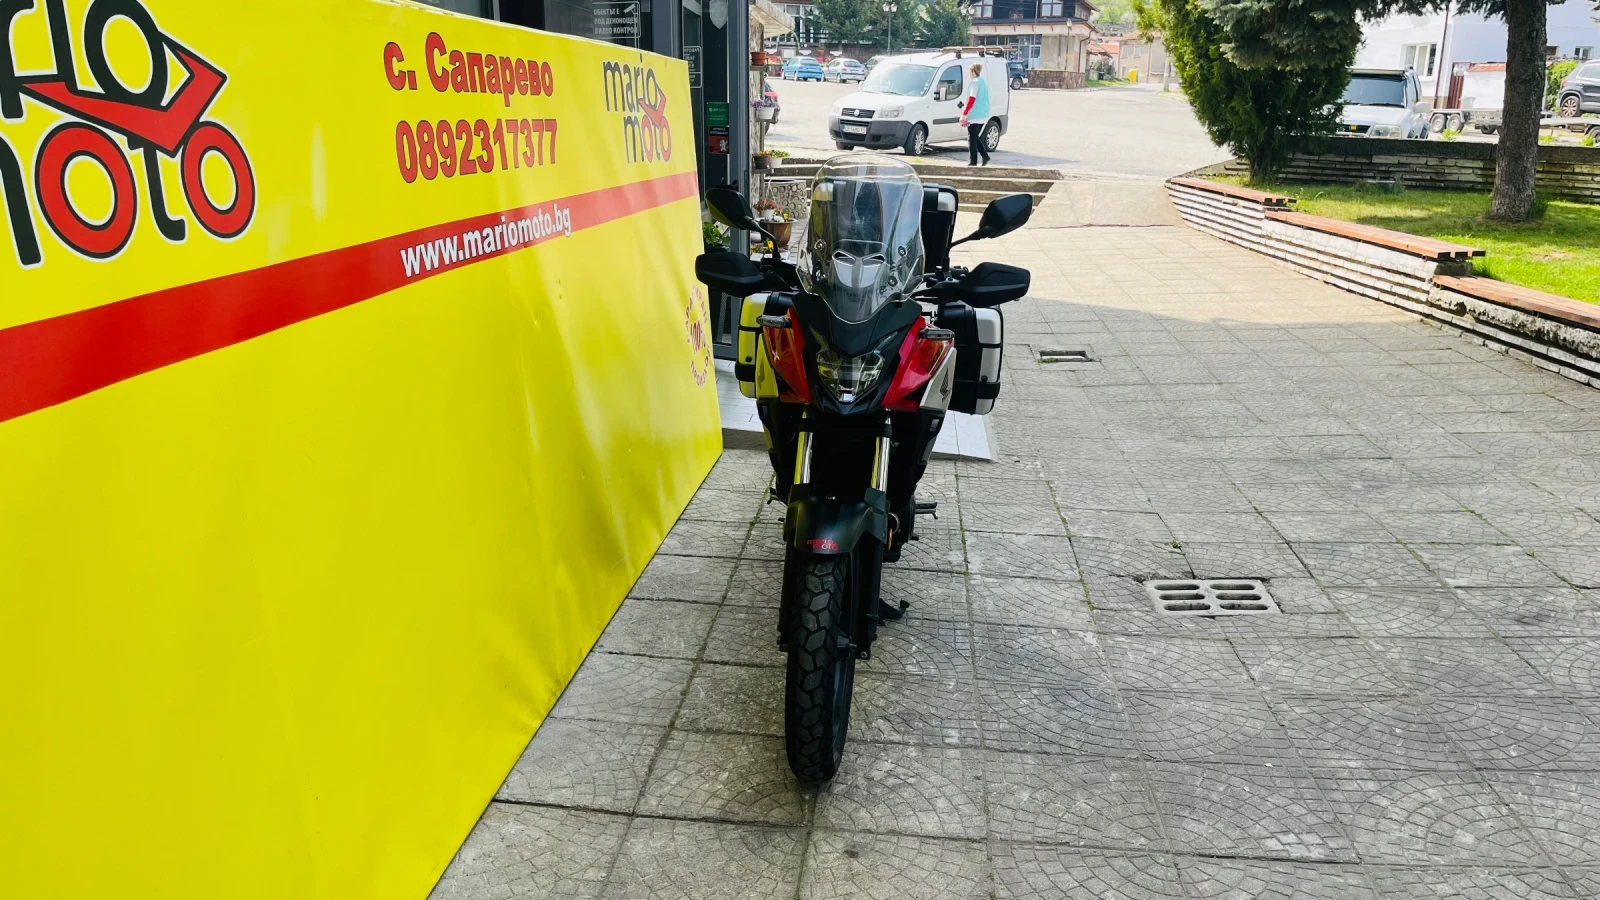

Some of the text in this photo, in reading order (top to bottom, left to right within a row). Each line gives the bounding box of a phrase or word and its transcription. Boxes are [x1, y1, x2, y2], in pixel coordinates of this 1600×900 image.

[425, 32, 554, 107] Сапарево
[603, 53, 658, 113] mario
[396, 119, 557, 184] 0892317377
[623, 115, 672, 164] moto
[400, 203, 572, 278] www.mariomoto.bg
